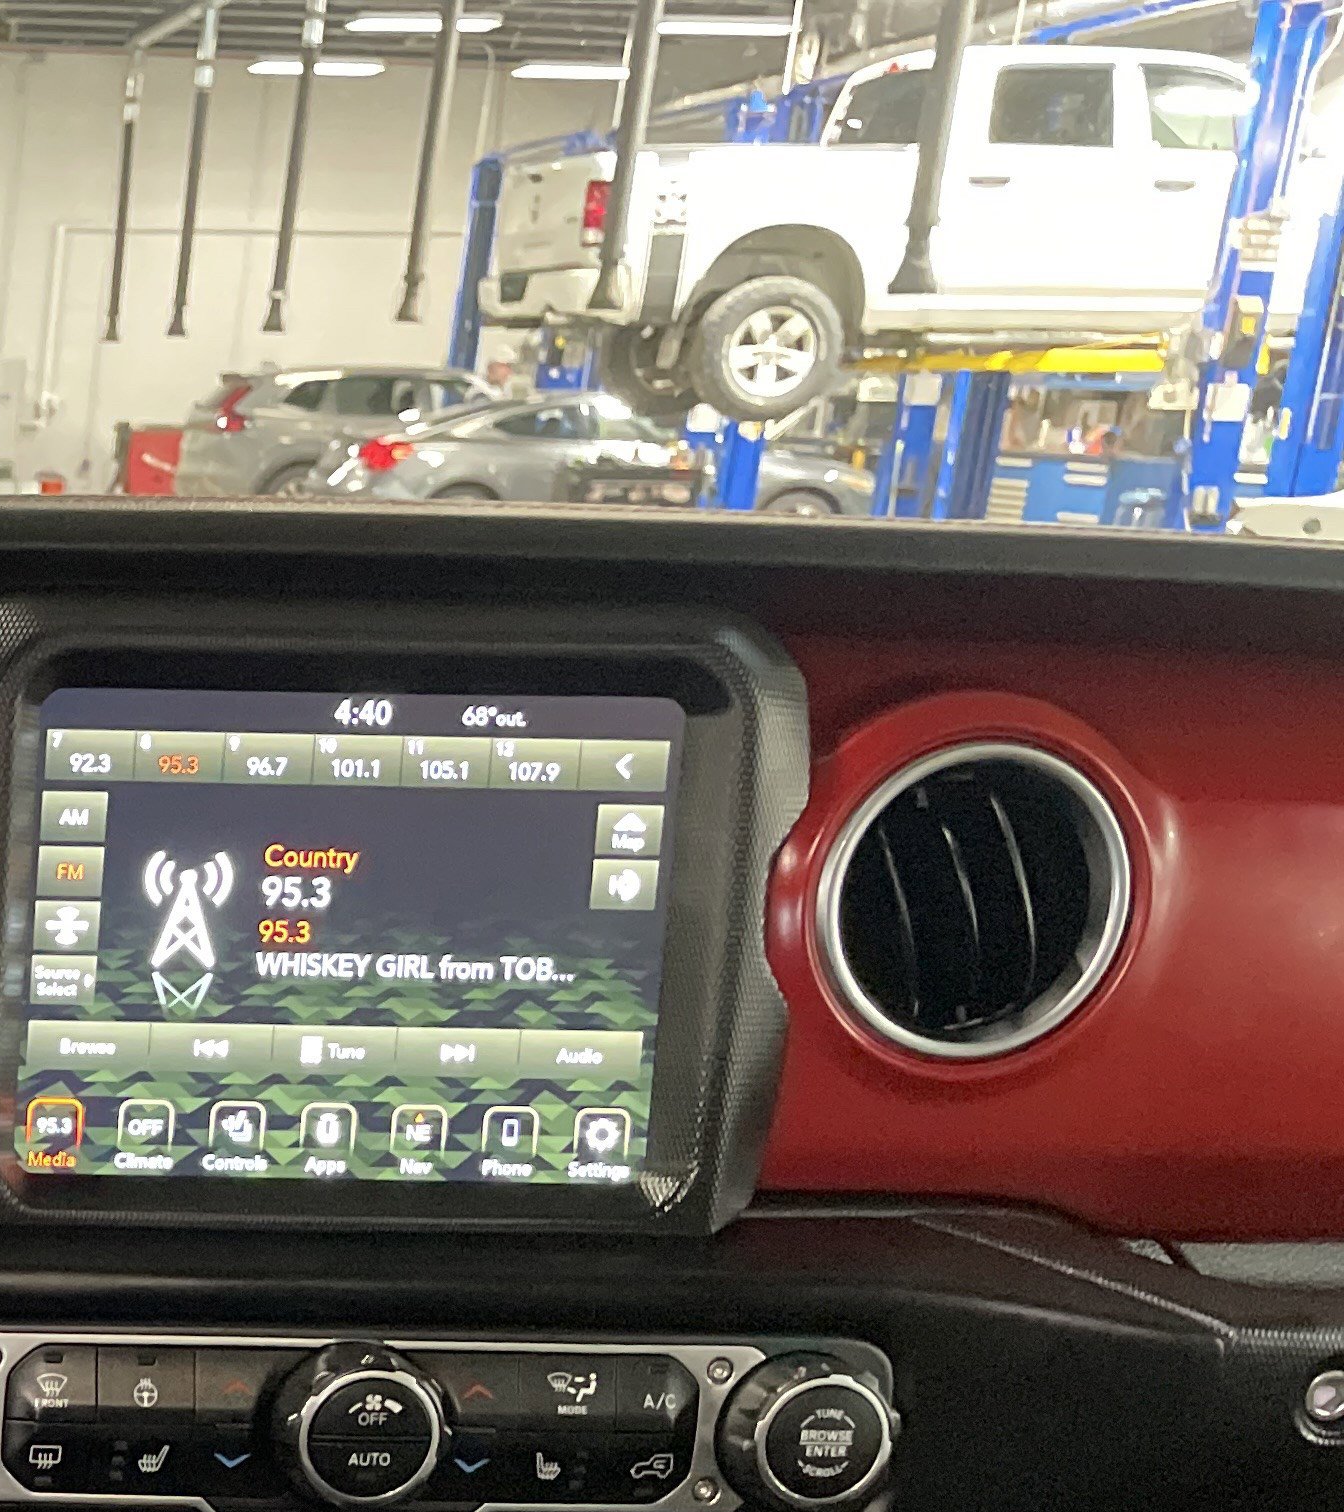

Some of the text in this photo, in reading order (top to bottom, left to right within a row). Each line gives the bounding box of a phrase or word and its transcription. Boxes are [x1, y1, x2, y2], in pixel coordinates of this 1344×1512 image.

[333, 699, 393, 726] 4:40
[69, 753, 112, 774] 92.3
[158, 755, 200, 775] 95.3
[246, 757, 288, 777] 96.7
[332, 758, 380, 778] 101.1
[419, 760, 469, 780] 105.1
[508, 762, 561, 783] 107.9
[59, 808, 89, 826] AM
[264, 843, 361, 874] Country
[56, 863, 85, 881] FM
[261, 876, 332, 909] 95.3
[258, 920, 311, 945] 95.3
[256, 951, 372, 978] WHISKEY
[375, 953, 437, 979] GIRL
[439, 954, 494, 980] from
[327, 1042, 366, 1061] Tune
[555, 1047, 603, 1065] Audio
[36, 1118, 72, 1135] 95.3
[128, 1119, 163, 1136] OFF
[27, 1151, 77, 1169] Media
[114, 1152, 174, 1170] Climate
[202, 1154, 268, 1172] Controls
[304, 1155, 346, 1175] Apps
[399, 1158, 433, 1175] Nav
[481, 1159, 532, 1177] Phone
[567, 1161, 631, 1180] Settings
[557, 1404, 588, 1415] MODE
[643, 1391, 677, 1411] A/C
[357, 1412, 388, 1427] OFF
[816, 1409, 844, 1421] TUNE
[800, 1429, 853, 1443] BROWSE
[348, 1452, 391, 1467] AUTO
[805, 1445, 848, 1458] ENTER
